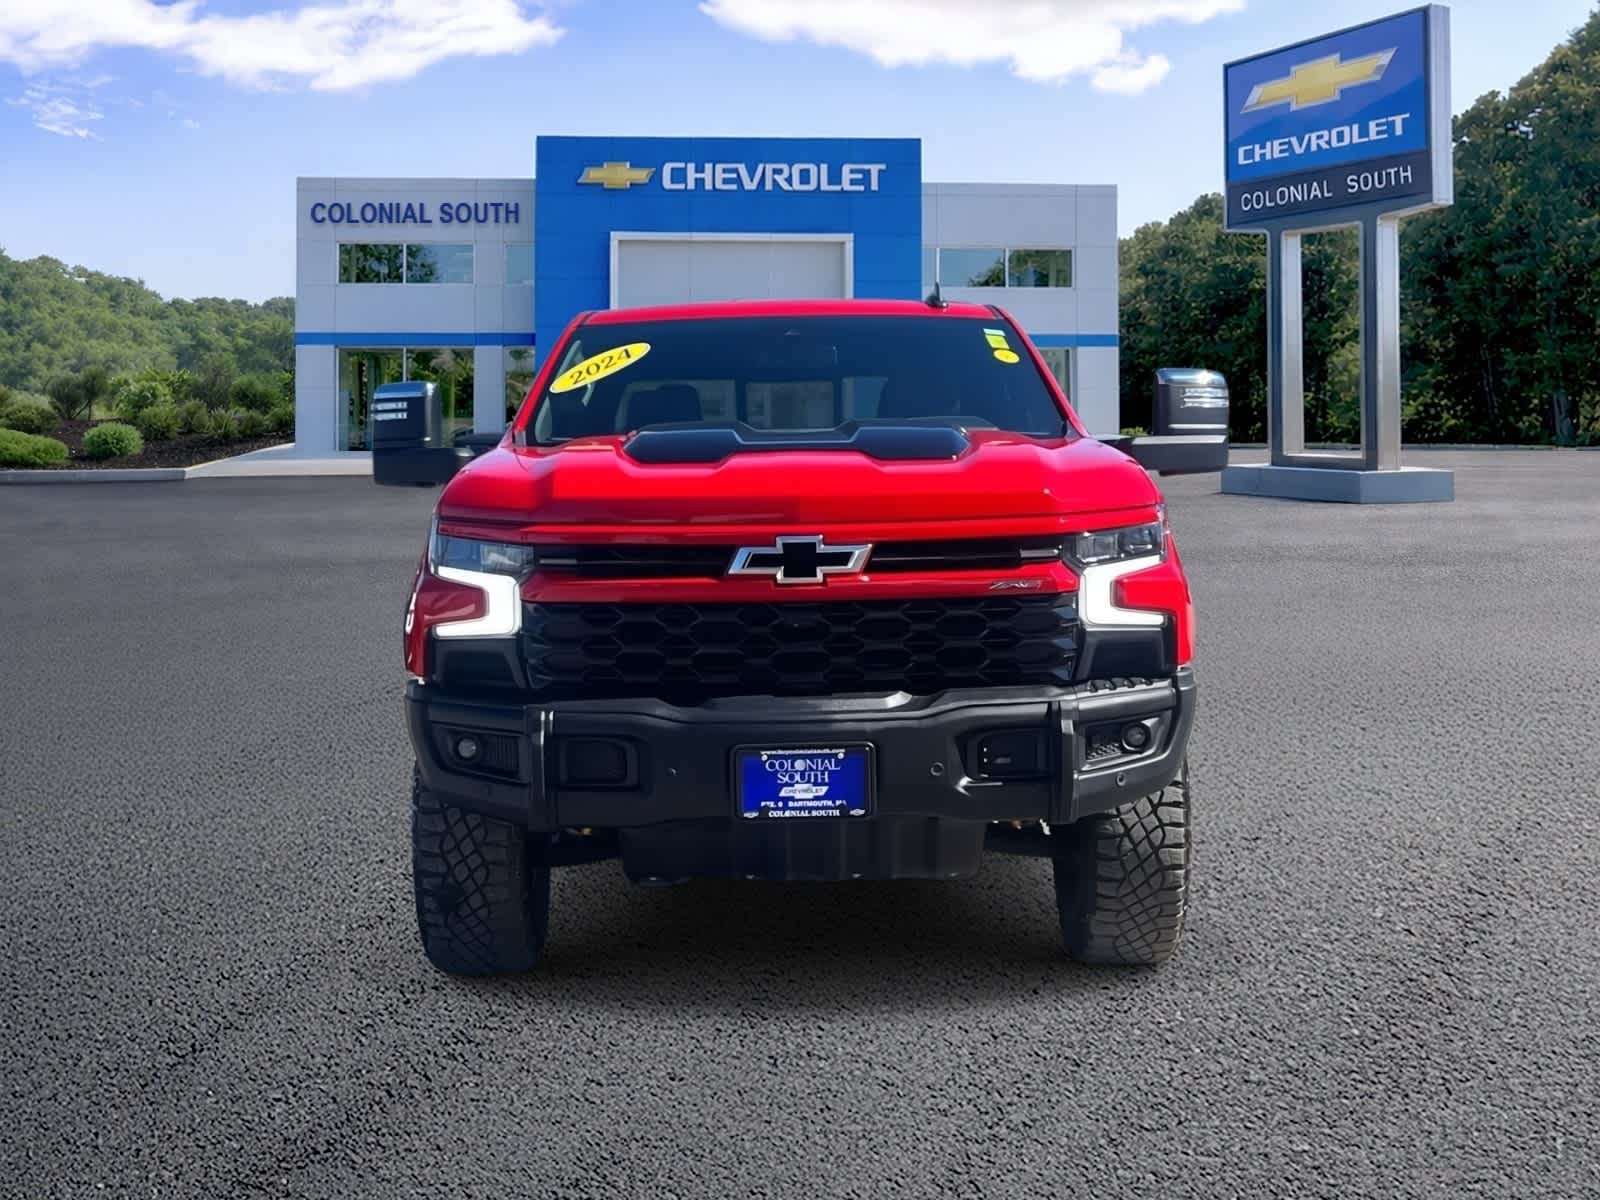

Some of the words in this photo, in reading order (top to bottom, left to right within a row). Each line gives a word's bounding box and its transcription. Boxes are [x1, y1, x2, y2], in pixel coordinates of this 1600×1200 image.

[1237, 113, 1410, 165] CHEVROLET
[661, 162, 887, 193] CHEVROLET
[1240, 180, 1333, 211] COLONIAL
[1346, 165, 1413, 193] SOUTH
[310, 202, 433, 224] COLONIAL
[439, 202, 521, 224] SOUTH
[570, 347, 632, 385] 2024
[765, 758, 841, 772] COLONIAL
[776, 771, 829, 784] SOUTH
[768, 810, 811, 818] COLONIAL
[811, 809, 840, 817] SOUTH
